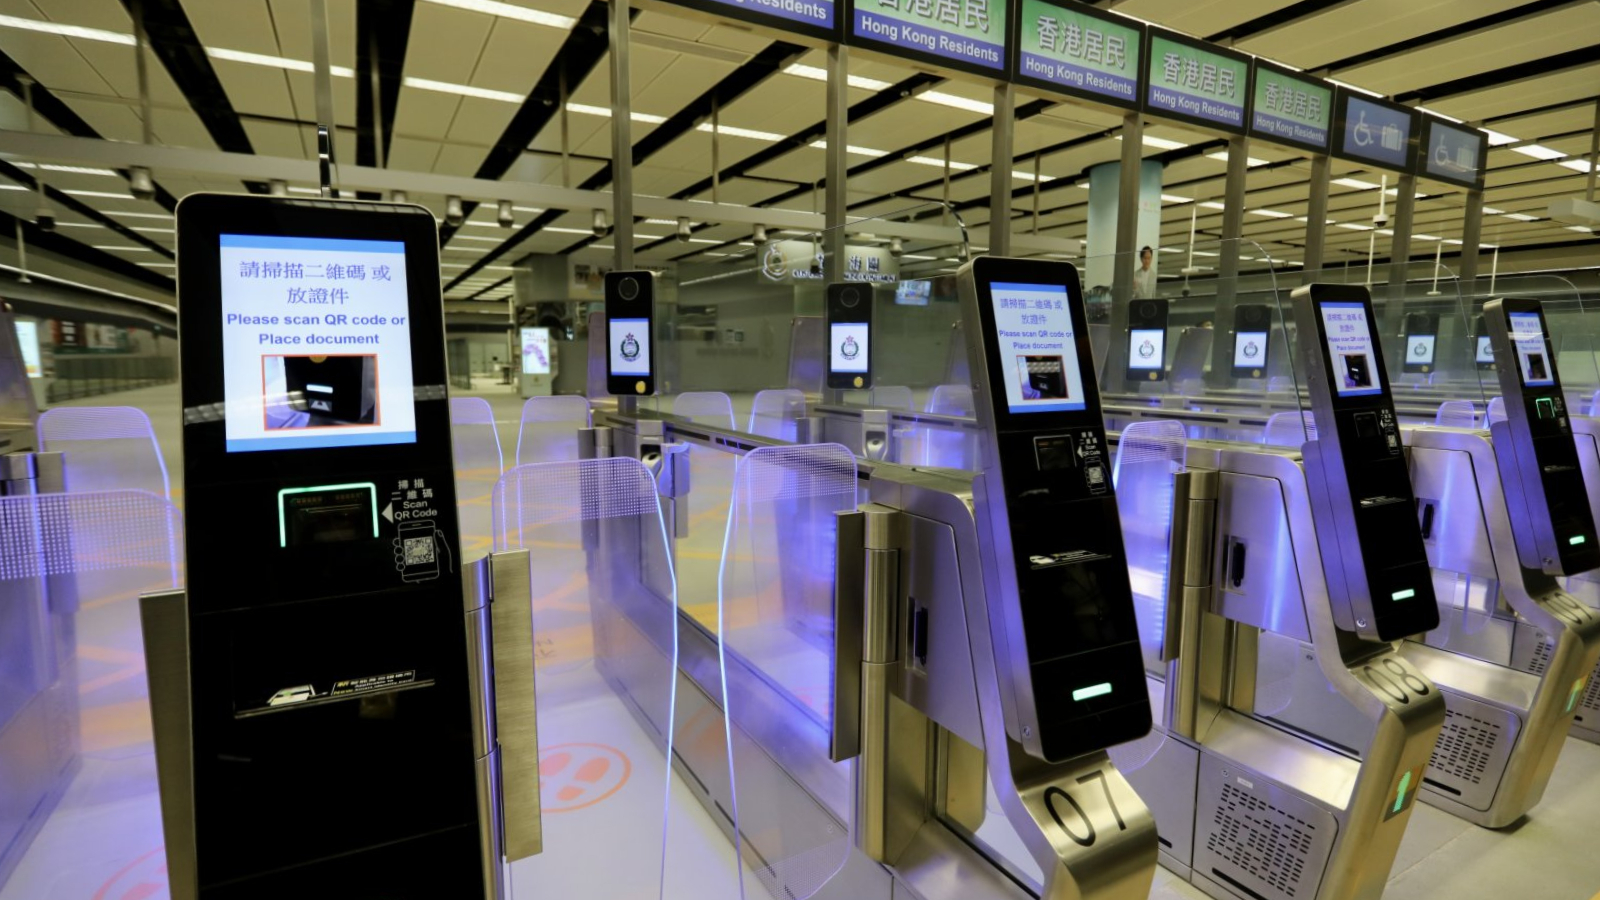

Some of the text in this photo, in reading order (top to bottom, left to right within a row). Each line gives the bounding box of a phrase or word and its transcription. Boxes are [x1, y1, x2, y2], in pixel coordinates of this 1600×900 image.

[879, 0, 989, 31] 居民
[862, 16, 999, 62] Hong Kong Residents
[1037, 16, 1124, 69] 香港居民
[1026, 57, 1132, 95] Hong Kong Residents
[1163, 52, 1235, 97] 香港居民
[1153, 90, 1240, 120] Hong Kong Residents
[1265, 81, 1322, 122] 香港居民
[1257, 115, 1324, 142] Hong Kong Residents
[239, 261, 391, 281] 請掃描二維碼 或
[287, 287, 349, 305] 放證件
[227, 313, 406, 326] Please scan QR code or
[259, 333, 380, 345] Place document
[394, 508, 438, 521] QR Code
[403, 500, 428, 509] Scan
[1542, 592, 1593, 625] 09
[1363, 658, 1430, 704] 08
[1044, 769, 1127, 847] 07
